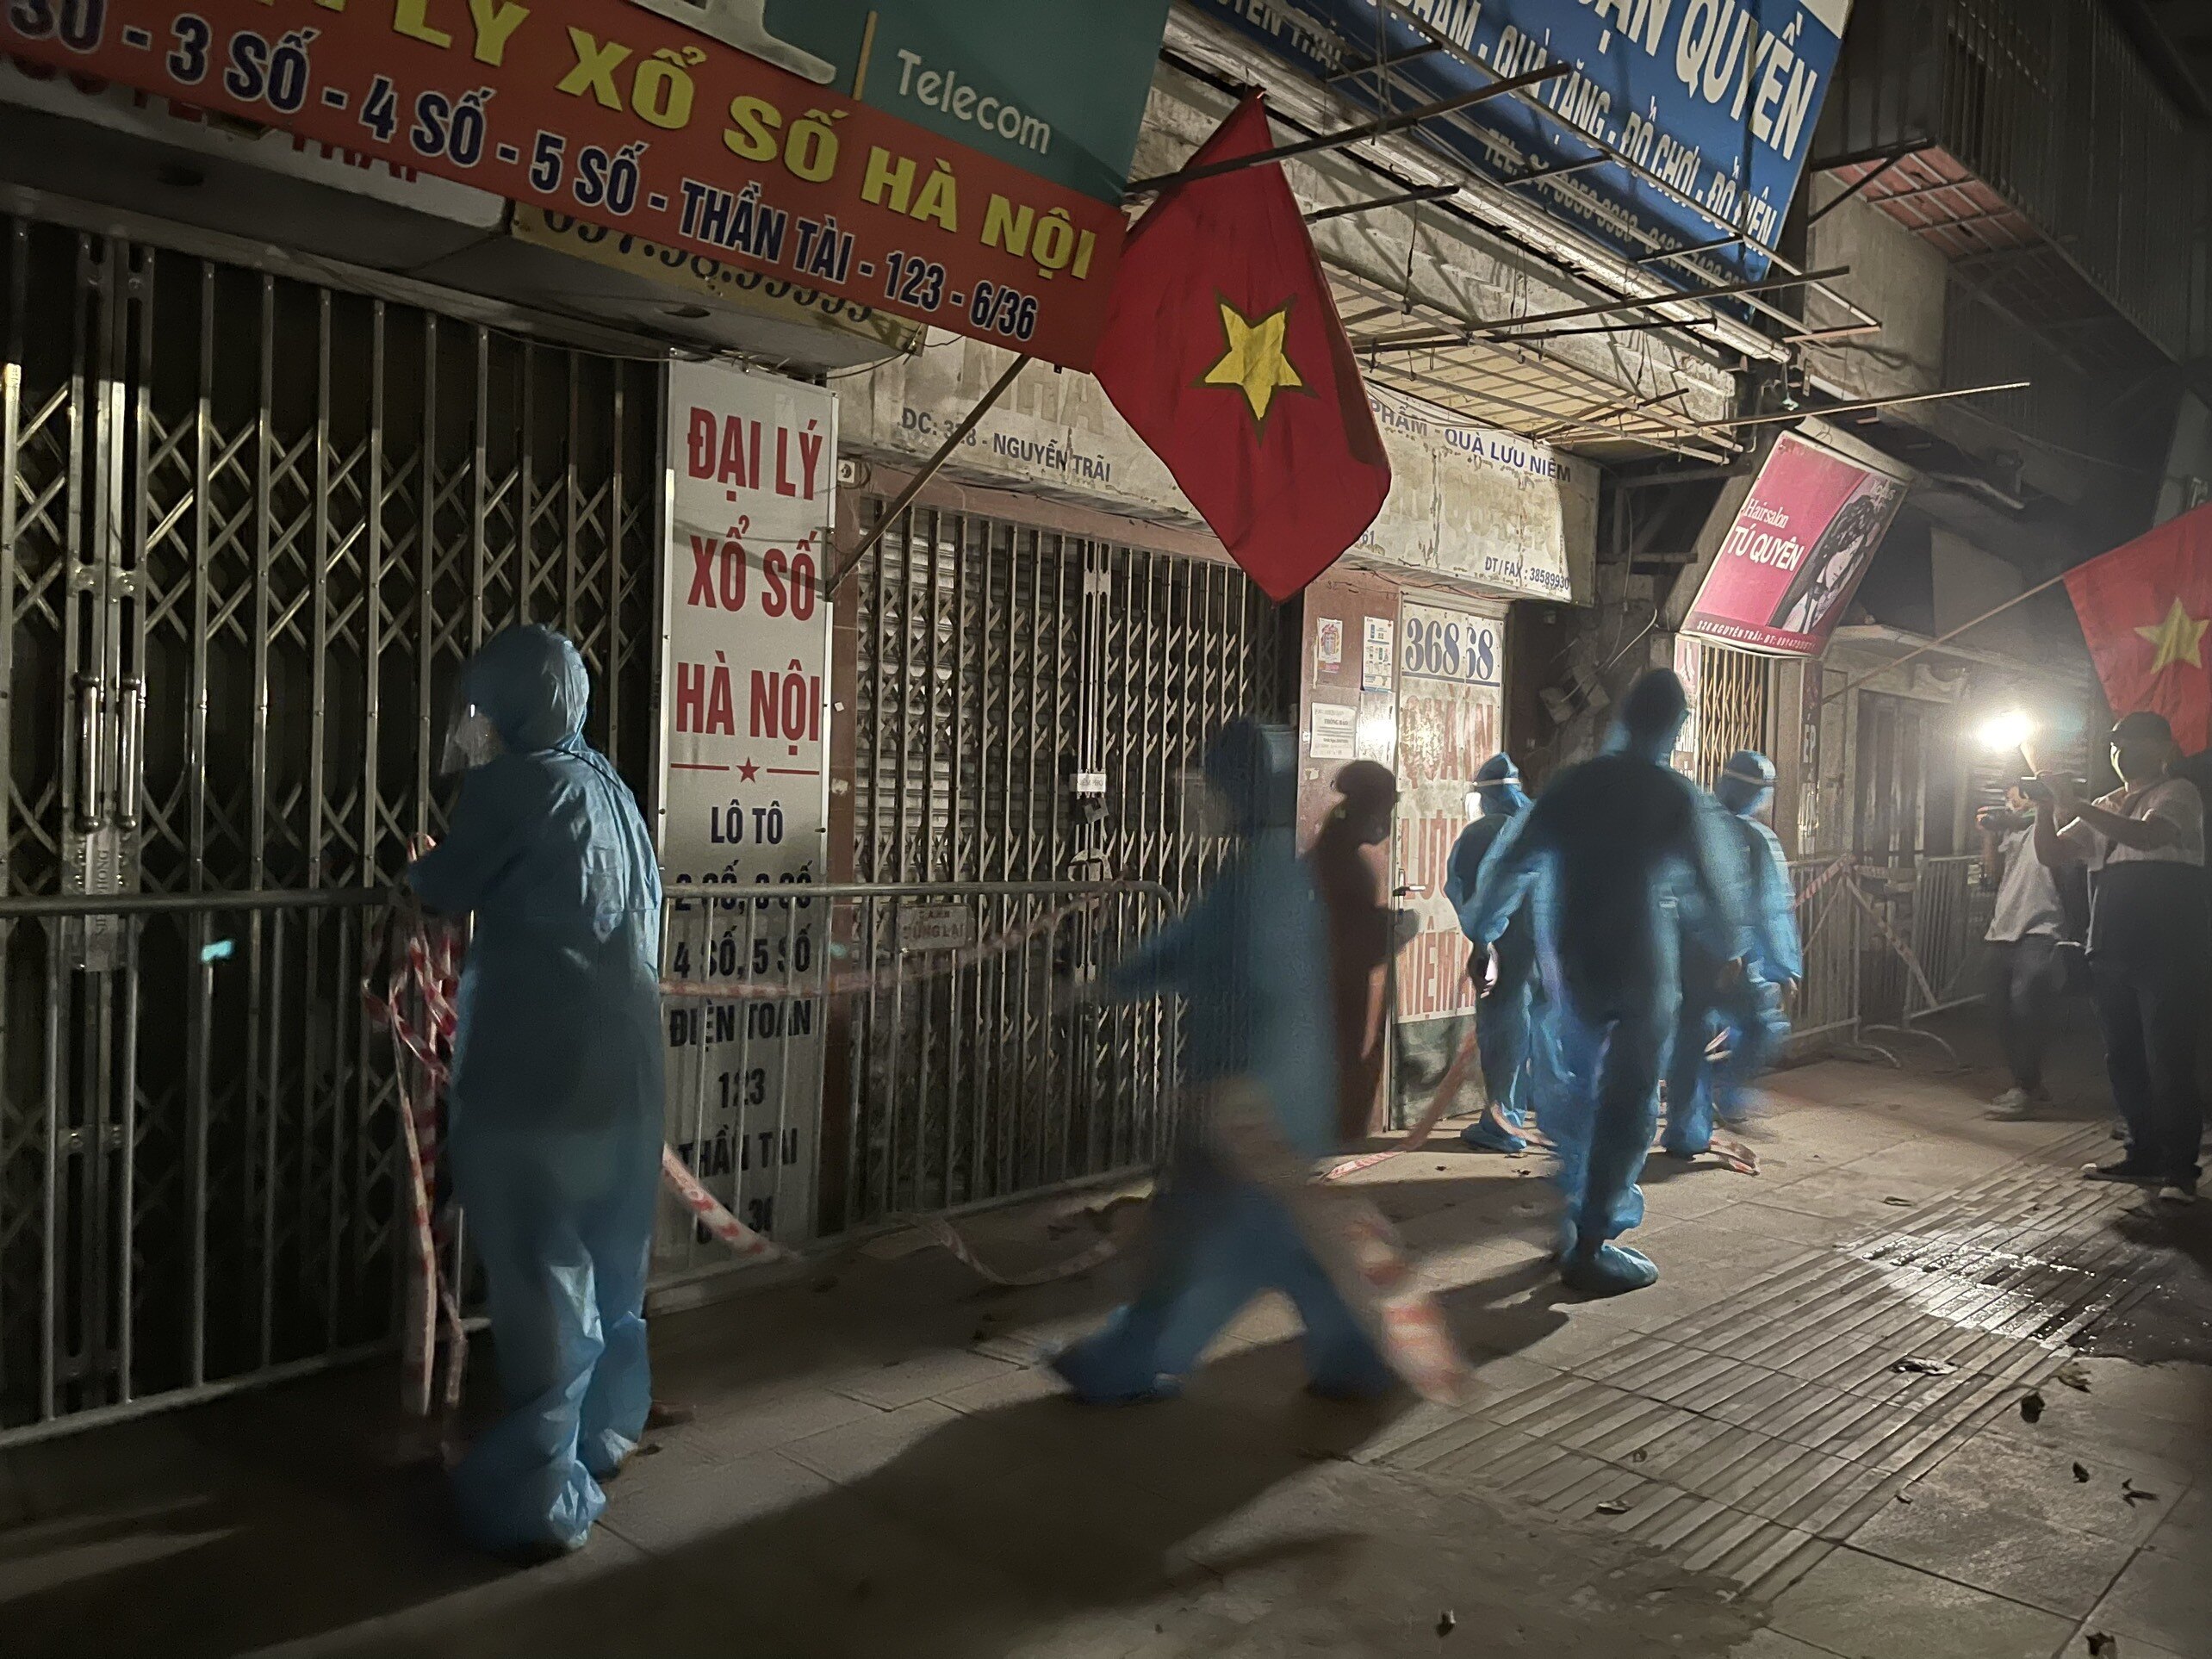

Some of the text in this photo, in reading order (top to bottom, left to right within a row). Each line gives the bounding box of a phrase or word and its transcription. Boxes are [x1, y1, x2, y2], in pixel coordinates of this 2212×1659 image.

[896, 49, 1051, 154] Telecom
[166, 13, 212, 85] 3
[224, 27, 321, 114] SỐ
[359, 74, 398, 143] 4
[409, 86, 496, 167] SỐ
[529, 129, 568, 193] 5
[572, 141, 649, 216] SỐ
[680, 177, 786, 264] THẦN
[794, 214, 855, 283] TÀI
[884, 251, 946, 312] 123
[968, 280, 1038, 341] 6/36
[556, 26, 706, 130] XỔ
[724, 96, 848, 183] SỐ
[861, 146, 957, 232] HÀ
[981, 193, 1097, 280] NỘI
[687, 407, 823, 502] ĐẠI LÝ
[943, 419, 977, 447] 38
[993, 432, 1067, 472] NGUYỄN
[1072, 454, 1111, 482] TRÃI
[1444, 428, 1484, 456] QUÀ
[1490, 441, 1525, 468] LƯU
[687, 514, 817, 621] XỔ SỐ
[1727, 523, 1805, 572] TÚ QUYÊN
[676, 649, 820, 755] HÀ NỘI
[711, 798, 783, 844] LÔ TÔ
[674, 941, 691, 979] 4
